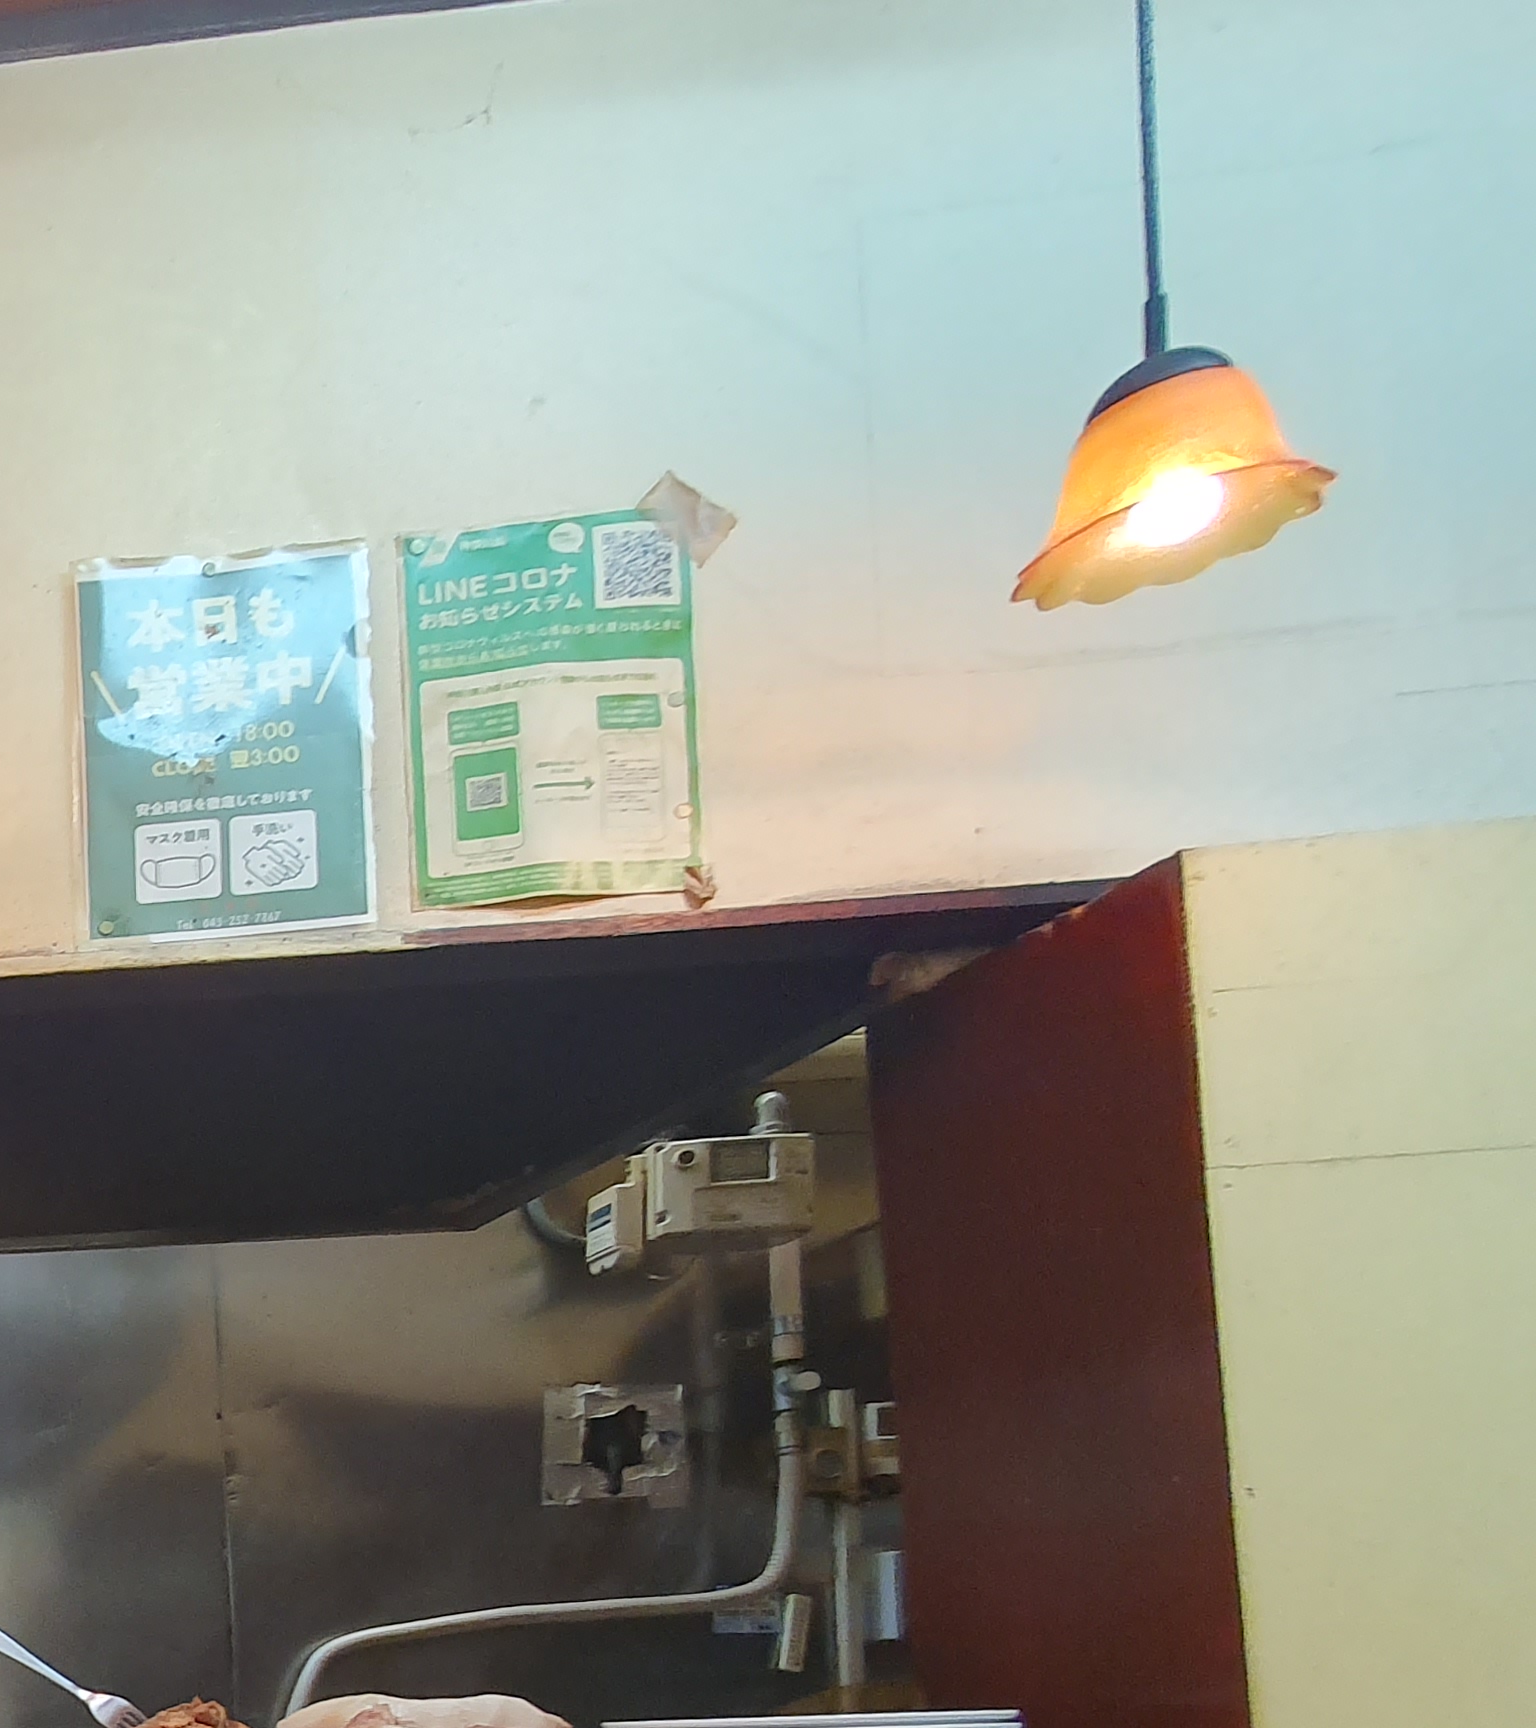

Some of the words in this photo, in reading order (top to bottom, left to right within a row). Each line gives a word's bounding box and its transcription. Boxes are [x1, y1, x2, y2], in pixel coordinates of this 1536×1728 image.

[418, 562, 578, 606] LINEコロナ
[130, 587, 296, 653] 本日も
[418, 592, 583, 631] お知らせシステム
[127, 649, 313, 719] 営業中
[151, 756, 218, 777] CLOE
[145, 828, 211, 845] マスク着用
